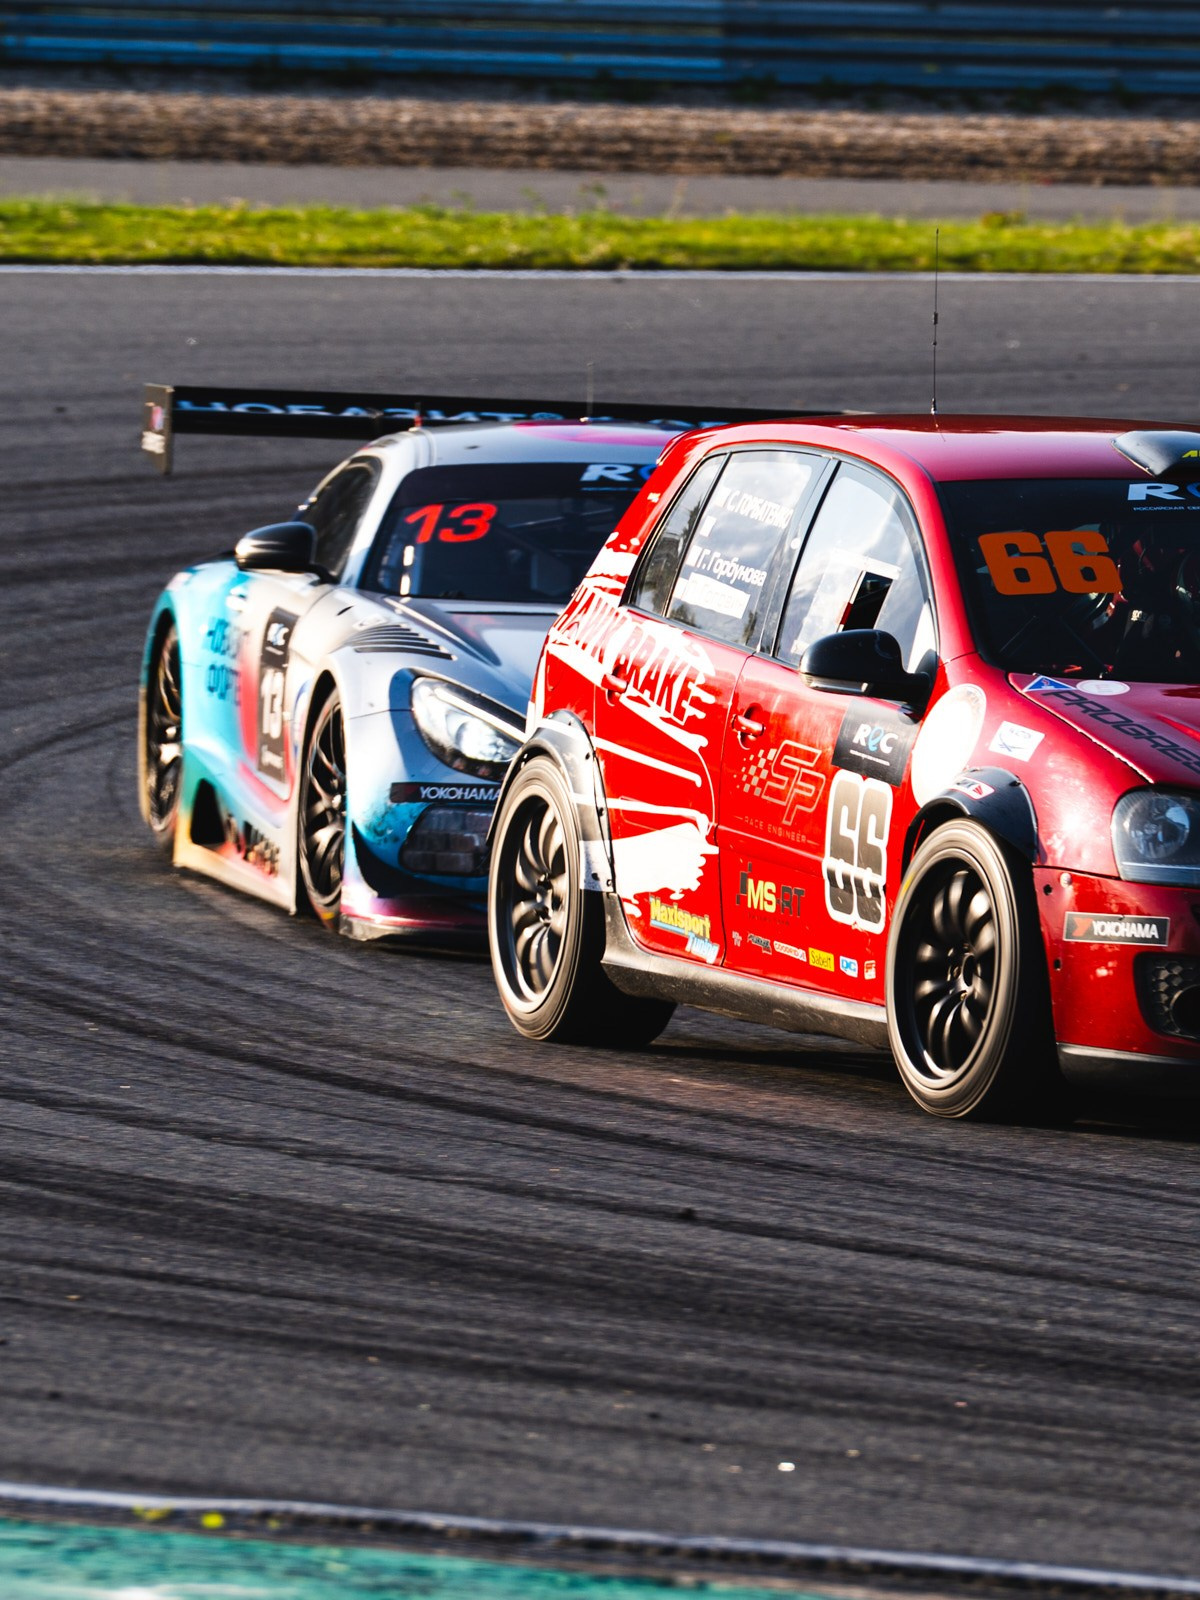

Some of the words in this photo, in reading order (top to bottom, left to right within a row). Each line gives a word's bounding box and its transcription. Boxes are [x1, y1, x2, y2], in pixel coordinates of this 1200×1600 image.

[404, 503, 498, 544] 13
[977, 531, 1124, 596] 66
[420, 785, 502, 800] YOKOHAMA
[744, 815, 764, 831] RACE
[767, 822, 808, 845] ENGINEER
[824, 770, 893, 934] 66
[650, 896, 710, 939] Maxisport
[1091, 920, 1159, 939] YOKOHAMA
[685, 932, 721, 965] Tuning
